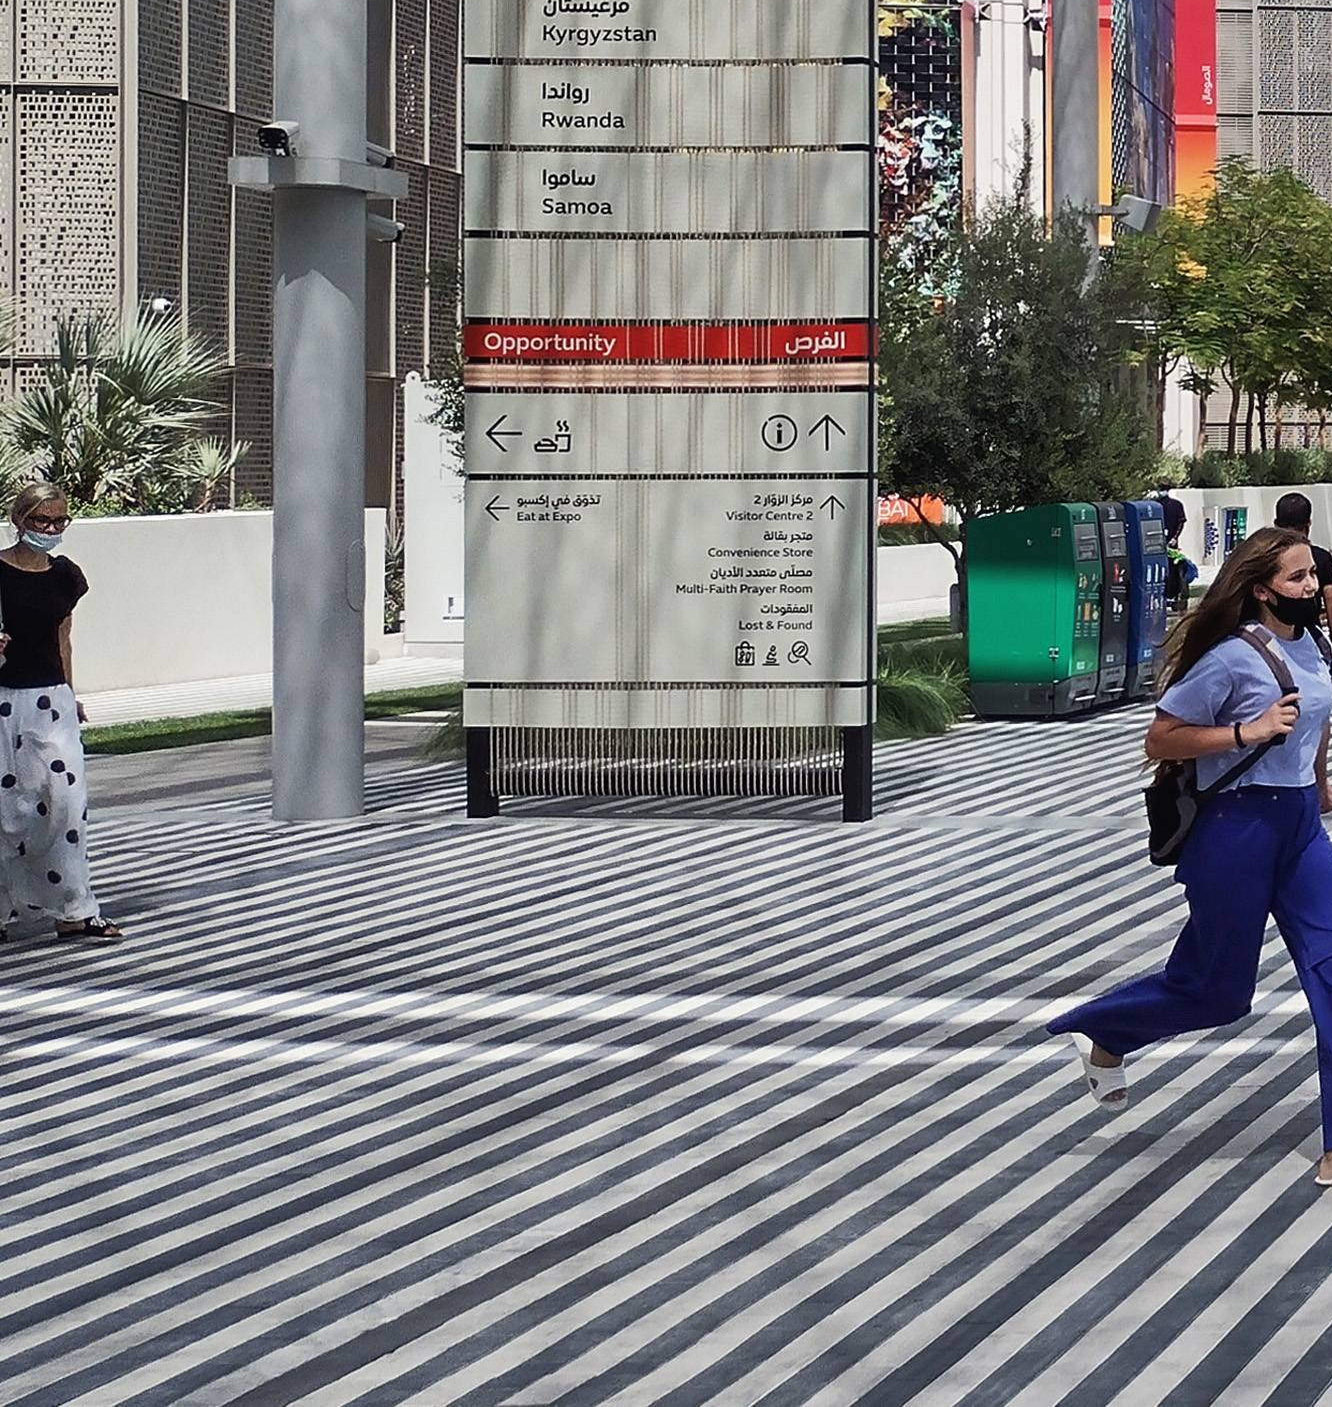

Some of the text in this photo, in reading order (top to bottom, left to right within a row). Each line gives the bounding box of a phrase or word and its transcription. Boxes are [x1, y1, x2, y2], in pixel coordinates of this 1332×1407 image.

[543, 25, 657, 44] Kyrgyzstan
[542, 83, 590, 103] رواندا
[542, 112, 625, 129] Rwanda
[543, 170, 596, 188] ساموا
[542, 198, 613, 215] Samoa
[484, 332, 617, 355] Opportunity
[785, 331, 846, 355] الفرص
[517, 495, 549, 508] إكسبو
[551, 495, 571, 510] في
[754, 495, 761, 505] 2
[791, 495, 813, 506] مركز
[517, 512, 581, 523] Eat at Expo
[726, 511, 813, 521] Visitor Centre 2
[763, 531, 813, 543] متجر بقالة
[708, 547, 813, 557] Convenience Store
[710, 566, 744, 580] الأديان
[745, 567, 777, 578] متعدد
[676, 584, 813, 596] Multi-Faith Prayer Room
[760, 604, 813, 616] المفقودات
[738, 620, 813, 630] Lost & Found
